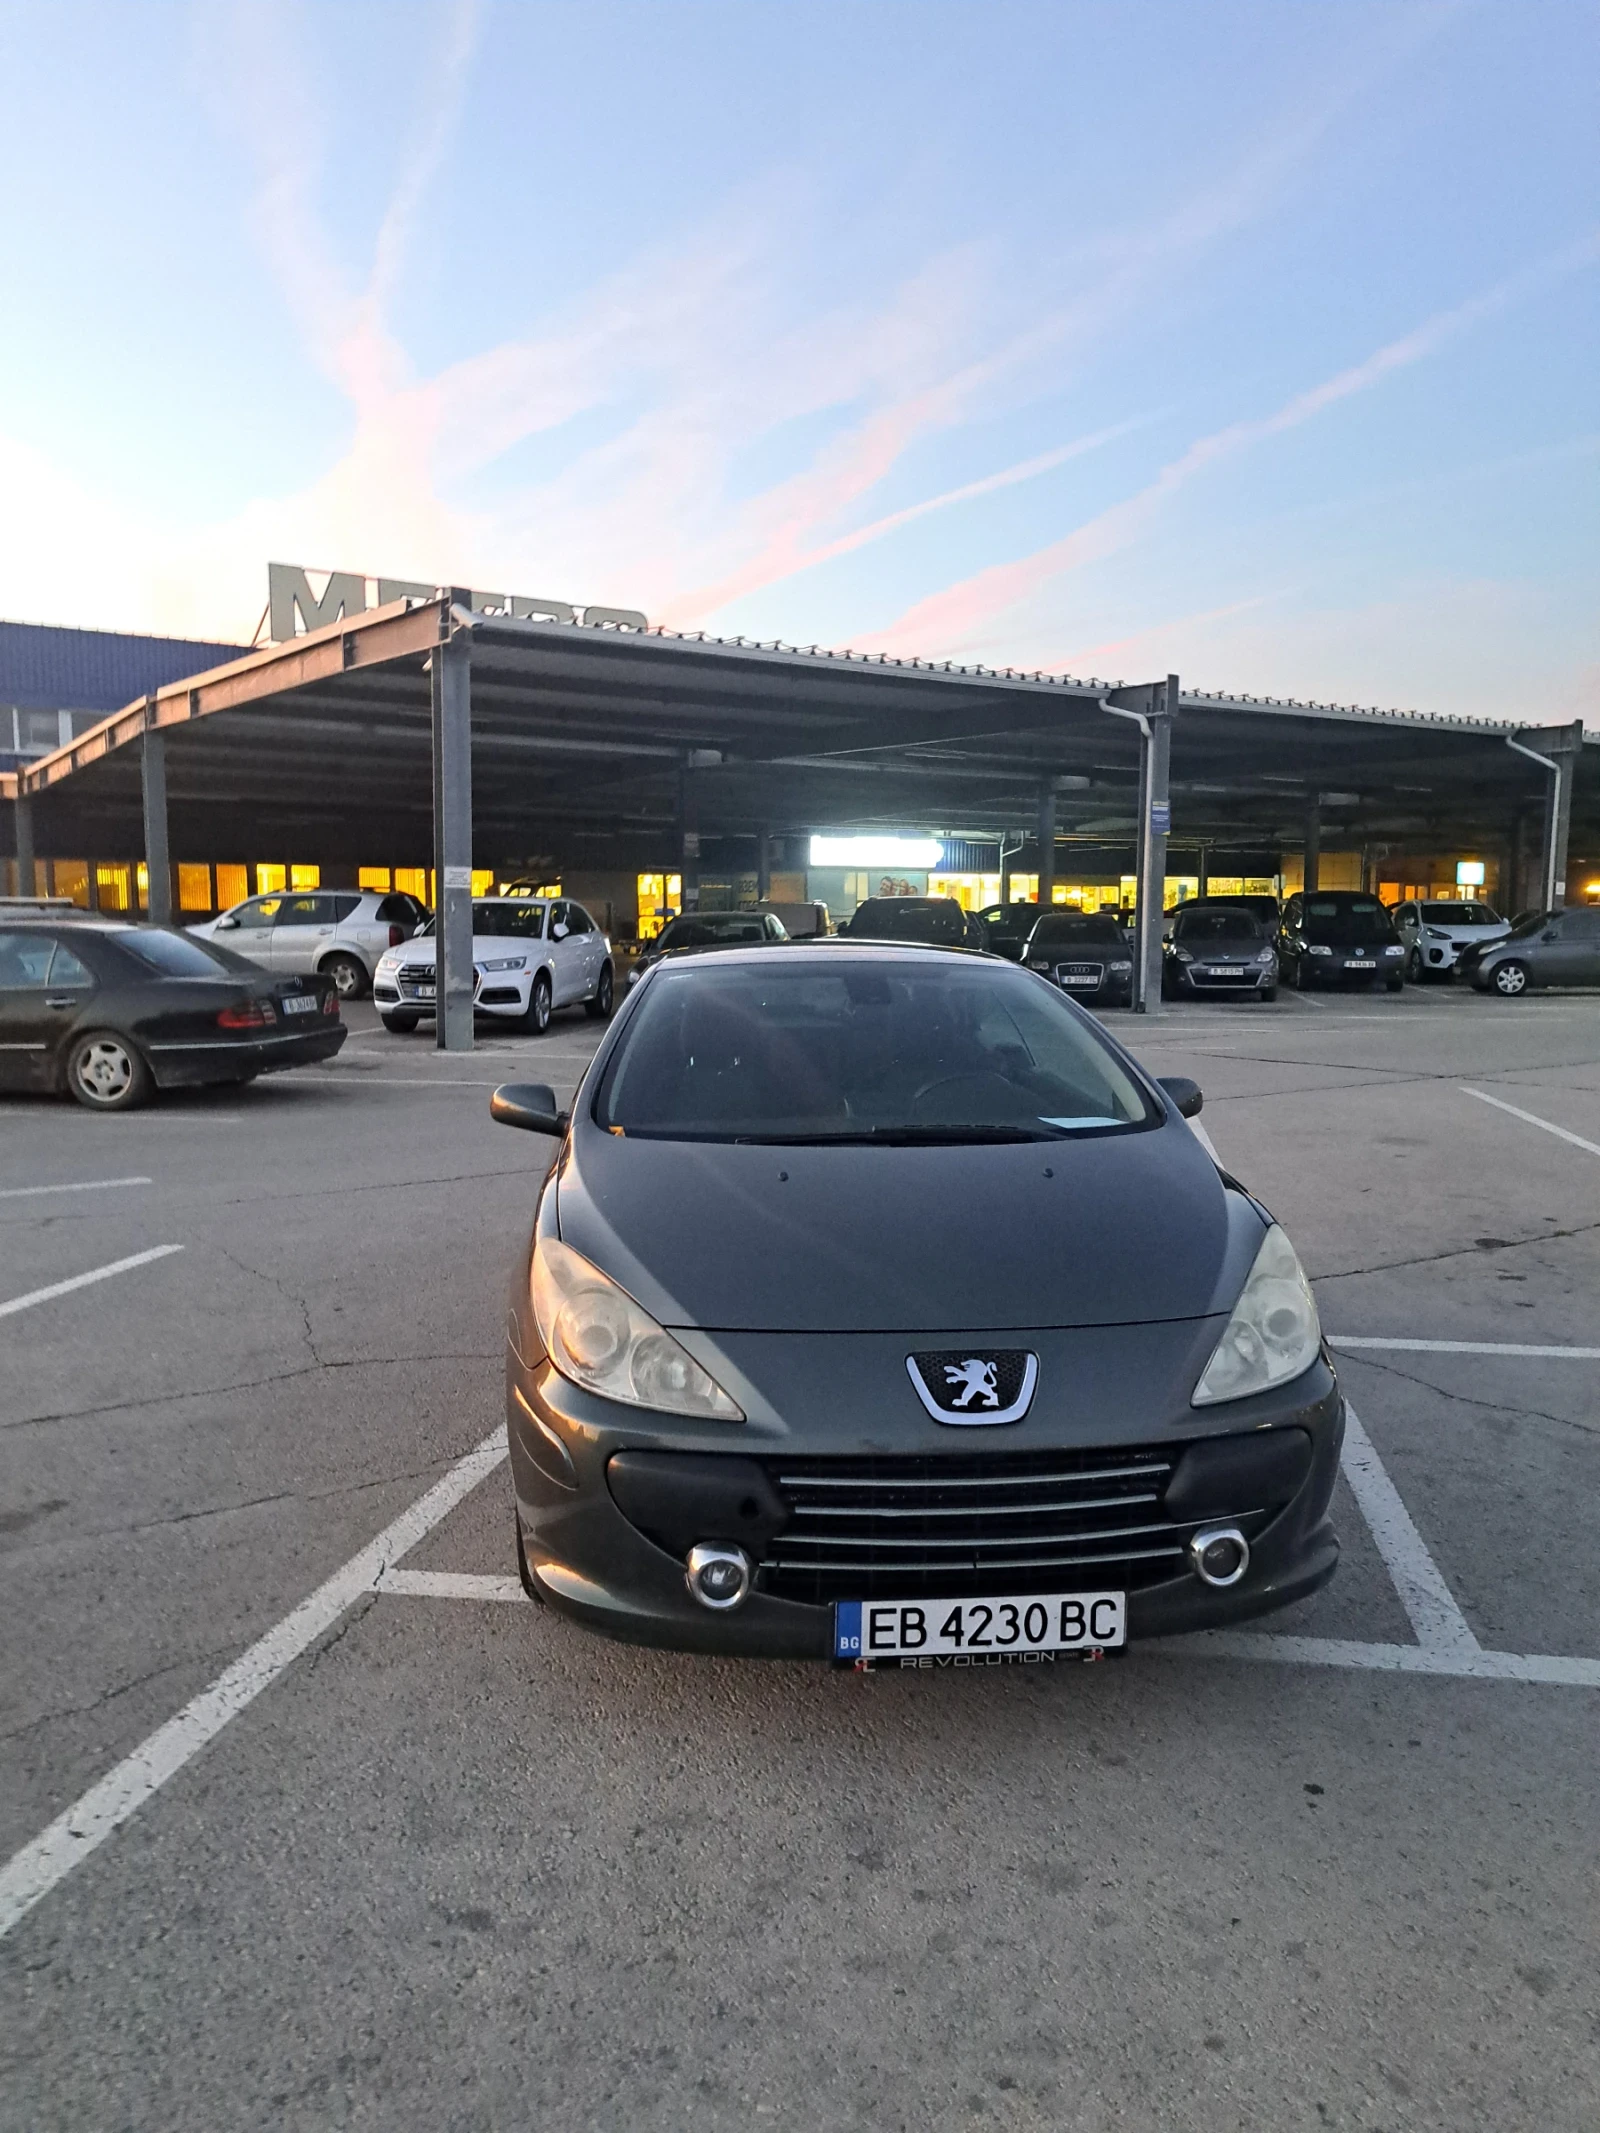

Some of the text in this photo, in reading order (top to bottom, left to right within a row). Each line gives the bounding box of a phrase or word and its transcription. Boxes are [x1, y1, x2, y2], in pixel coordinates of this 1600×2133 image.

[869, 1599, 1117, 1650] EB 4230 BC
[840, 1636, 860, 1650] BG
[900, 1651, 1055, 1669] REVOLUTION
